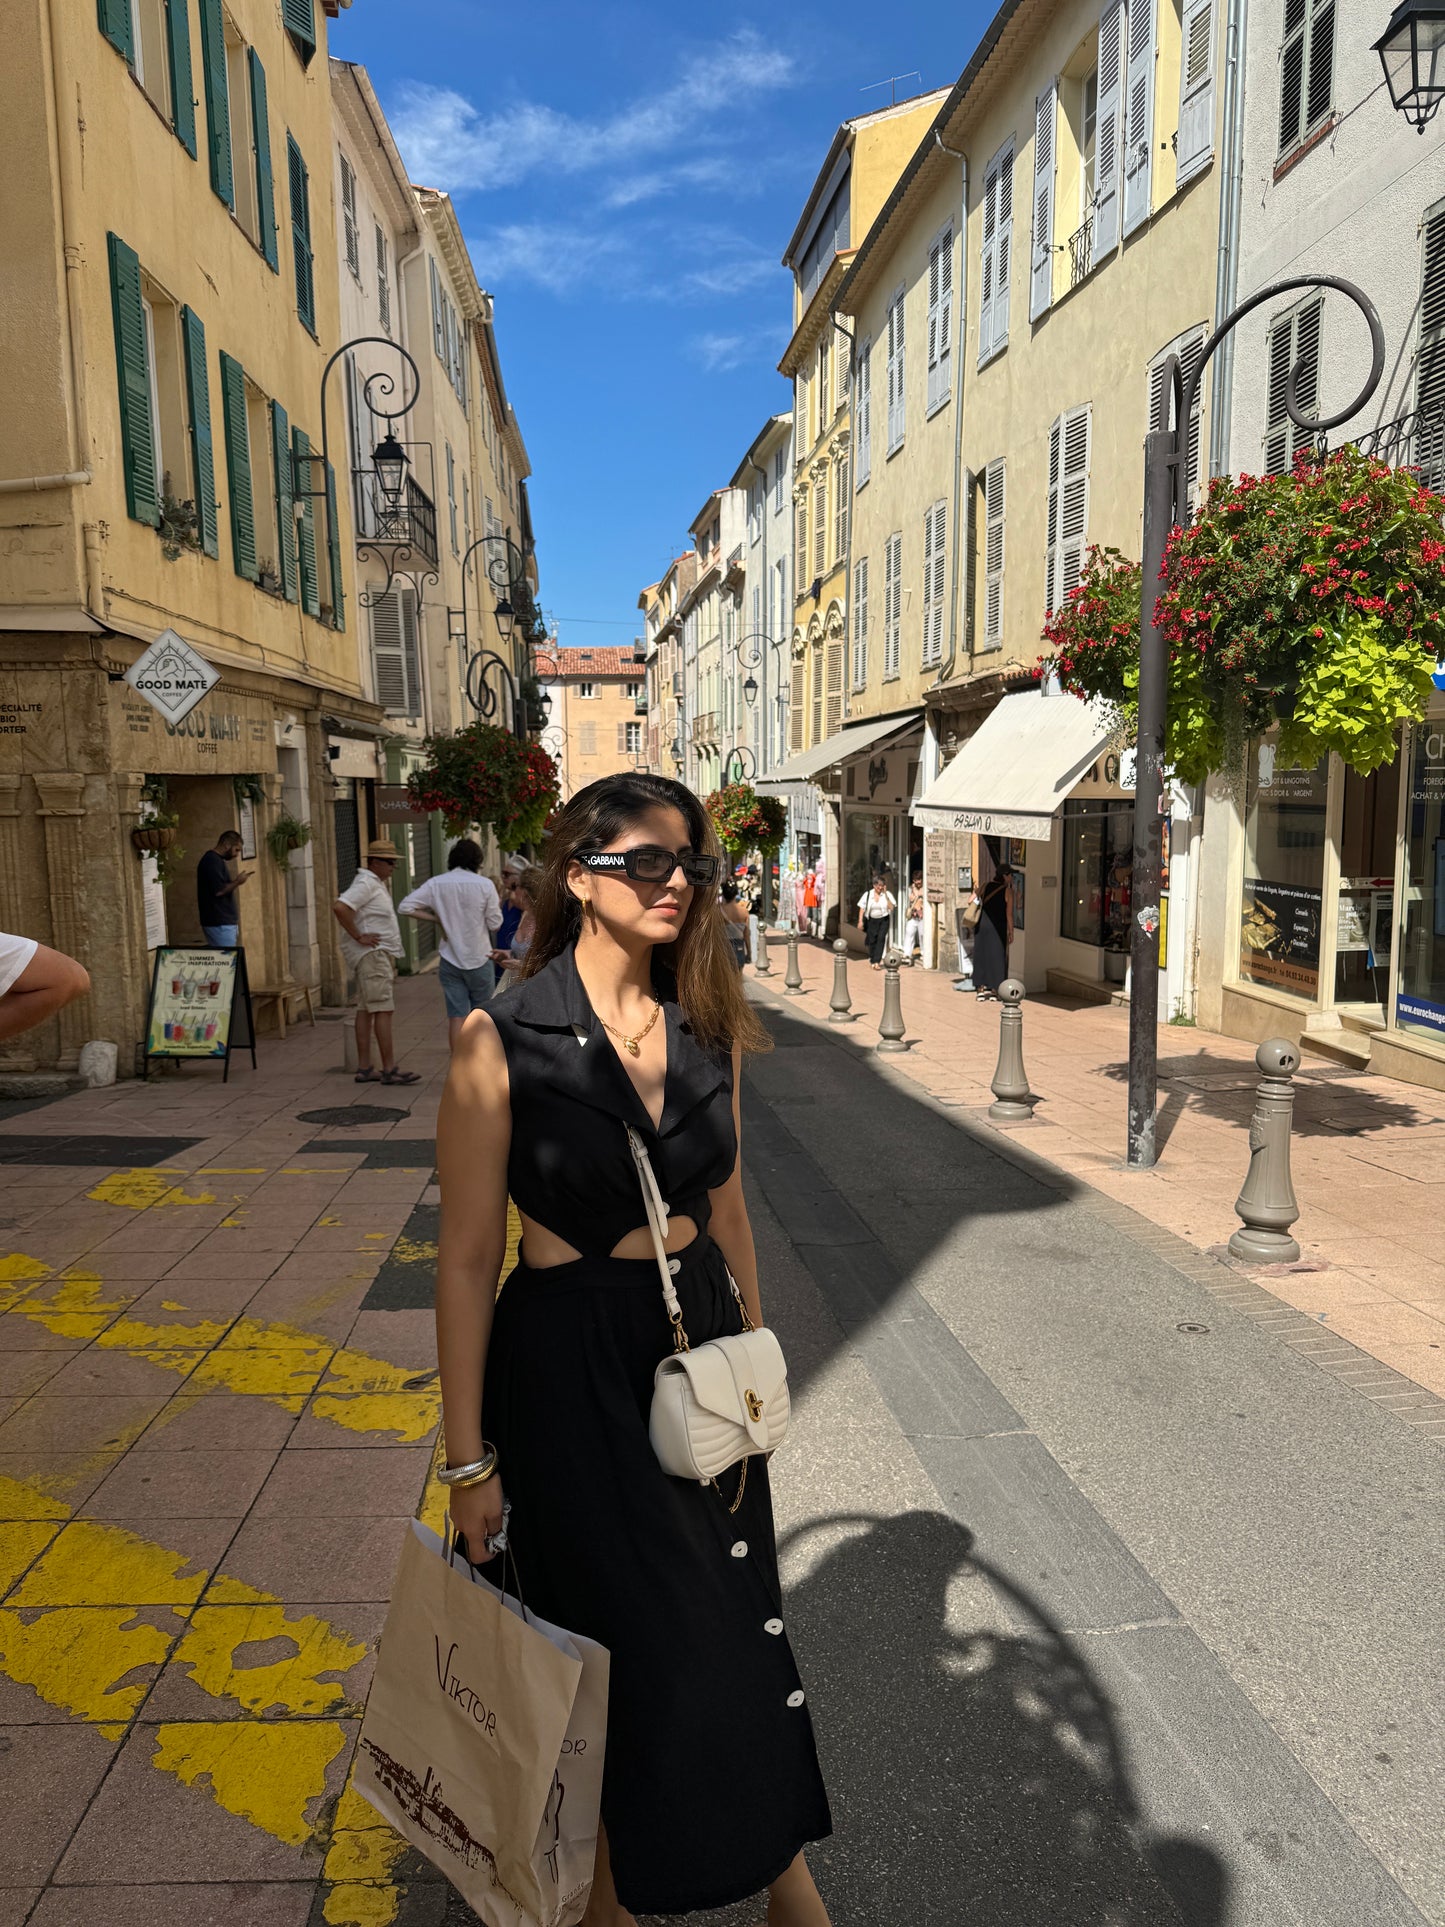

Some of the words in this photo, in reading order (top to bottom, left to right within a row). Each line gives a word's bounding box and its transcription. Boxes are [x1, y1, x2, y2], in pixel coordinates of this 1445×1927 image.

[136, 680, 172, 690] GOOD
[176, 680, 208, 690] MATE
[0, 702, 42, 713] ÉCIALITÉ
[197, 743, 218, 754] COFFEE
[1423, 777, 1445, 786] FOREIG
[1411, 791, 1432, 800] ACHAT
[1433, 791, 1439, 800] &
[435, 1634, 497, 1737] VIKTOR
